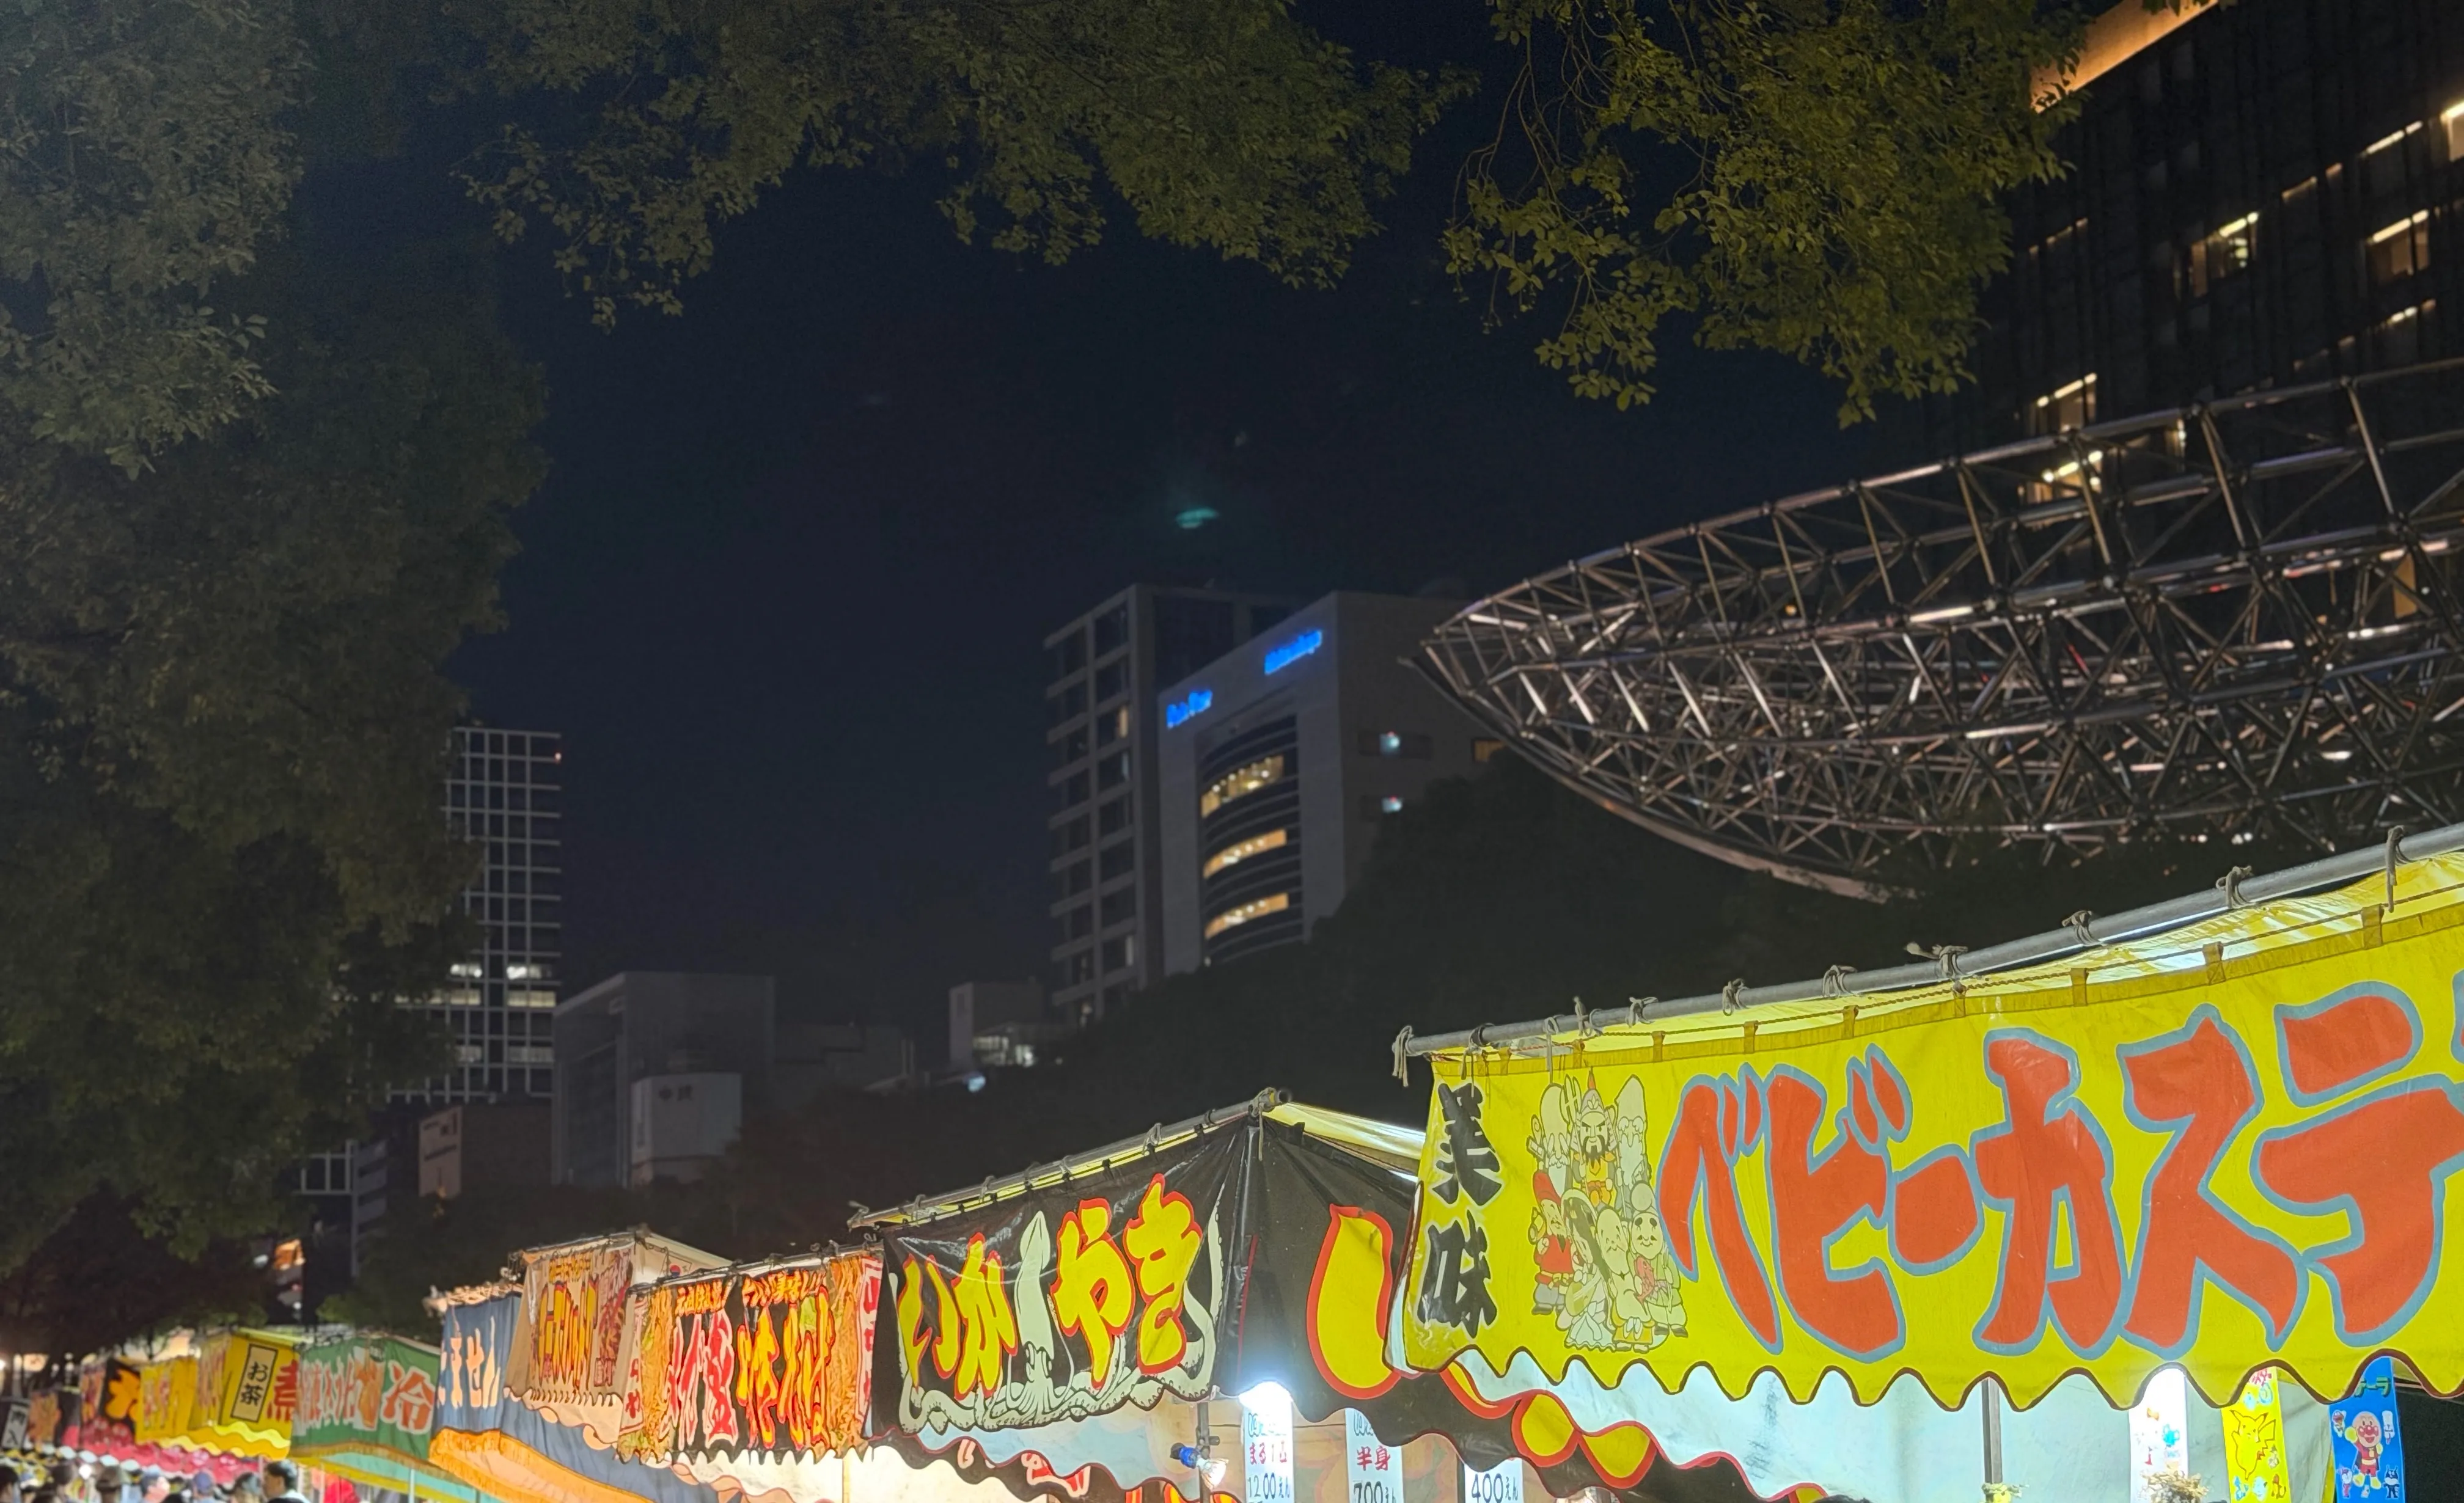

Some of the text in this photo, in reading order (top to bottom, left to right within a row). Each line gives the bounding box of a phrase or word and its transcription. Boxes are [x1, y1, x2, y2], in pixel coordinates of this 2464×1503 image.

[1418, 1083, 1502, 1339] 美味
[1656, 970, 2464, 1362] ベビーカステ
[898, 1174, 1202, 1400] いかやき
[240, 1362, 269, 1406] お茶
[1356, 1446, 1391, 1471] 半身
[1472, 1473, 1519, 1503] 400えん
